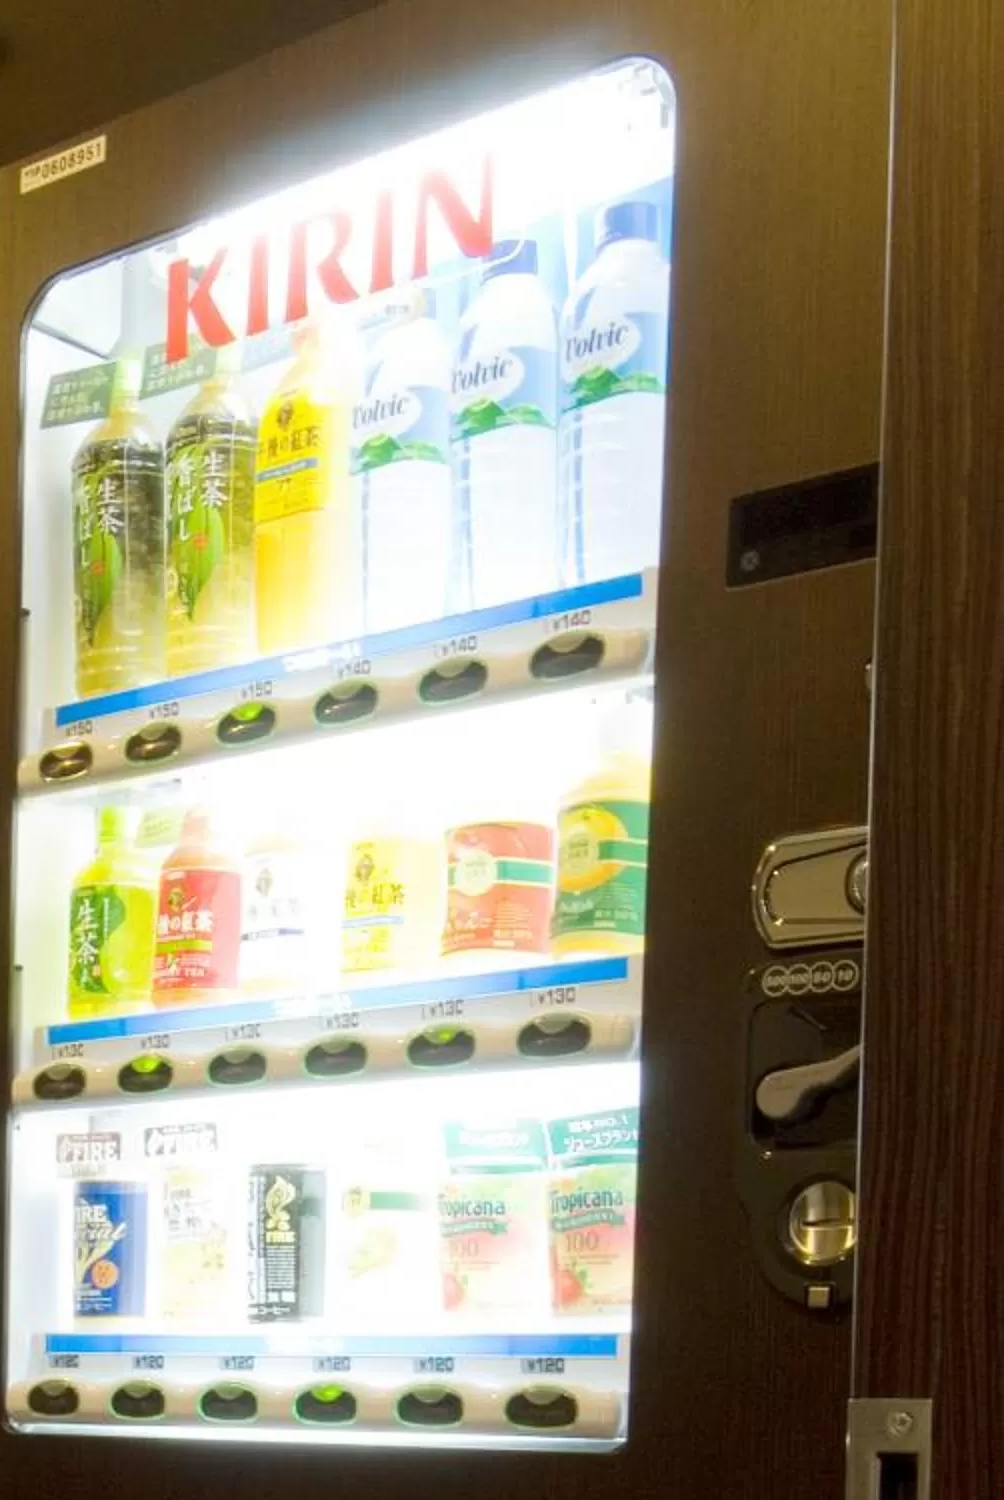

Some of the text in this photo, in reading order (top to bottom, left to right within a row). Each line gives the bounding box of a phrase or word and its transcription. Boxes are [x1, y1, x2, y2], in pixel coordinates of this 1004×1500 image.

[165, 151, 494, 367] KIRIN
[97, 478, 125, 534] 生茶
[200, 451, 228, 508] 生茶
[549, 1187, 624, 1216] Tropicana
